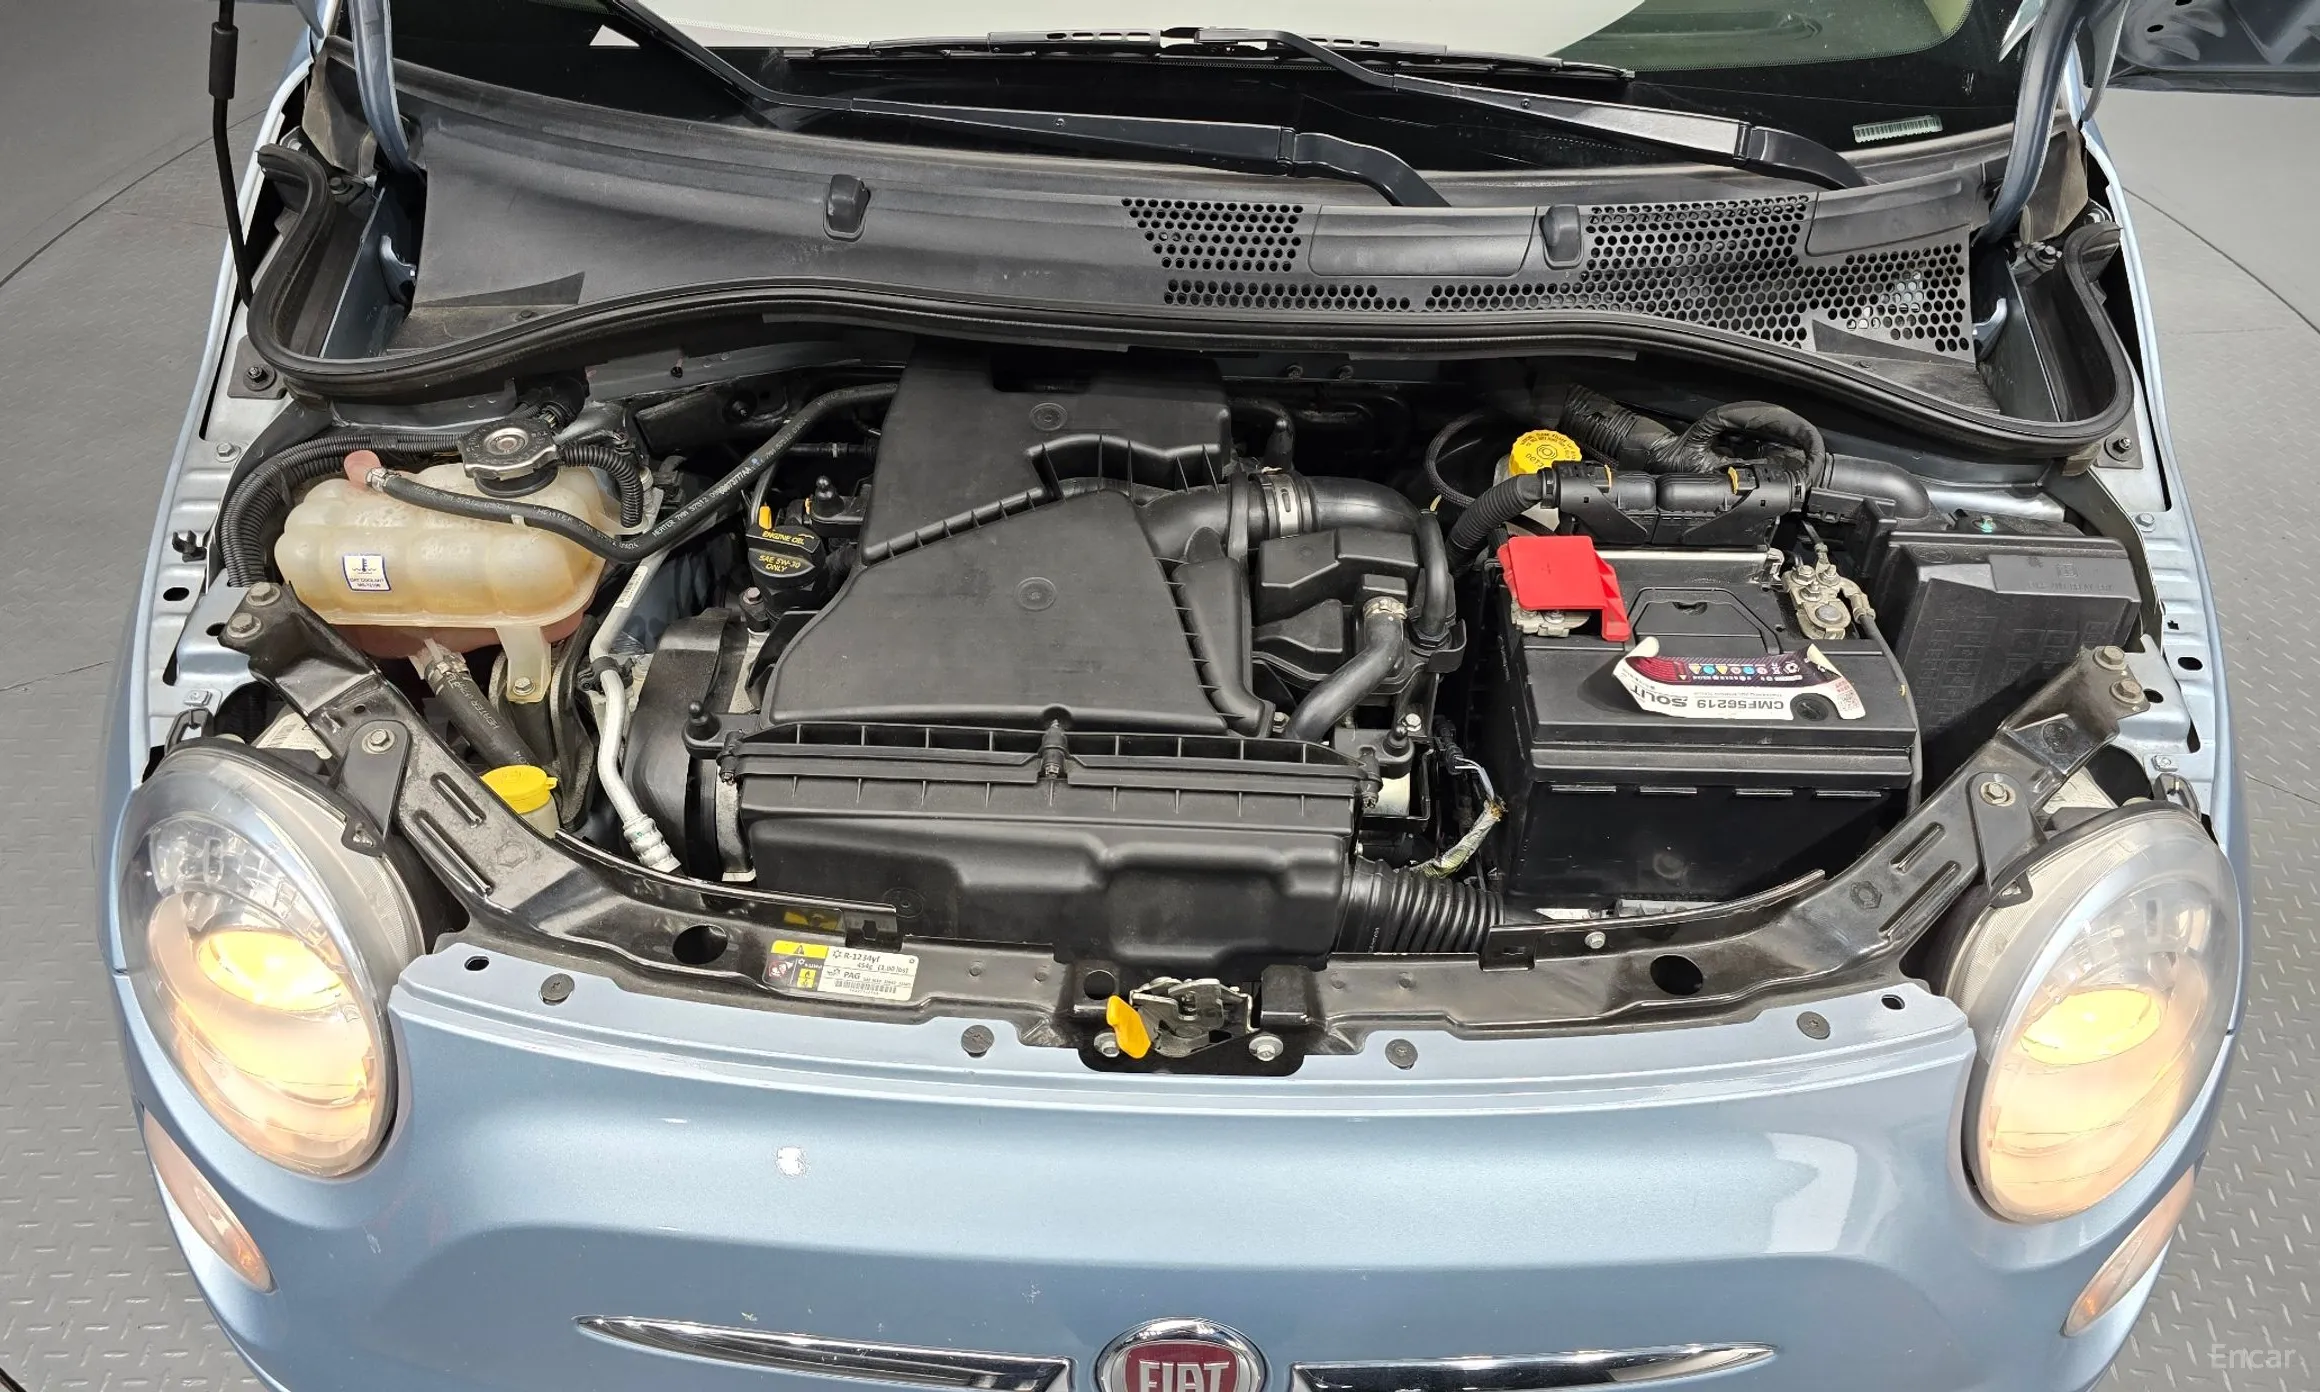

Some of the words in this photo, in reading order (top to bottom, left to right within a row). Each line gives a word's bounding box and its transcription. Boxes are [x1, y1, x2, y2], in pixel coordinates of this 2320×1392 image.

[762, 530, 791, 542] ENGINE
[791, 536, 805, 546] OIL
[759, 555, 775, 563] SAE
[775, 557, 802, 569] 5W-30
[765, 563, 788, 573] ONLY
[1697, 699, 1784, 710] CMF56219
[843, 952, 881, 963] R-1234yf
[843, 971, 861, 980] PAG
[1139, 1359, 1230, 1392] FIAT
